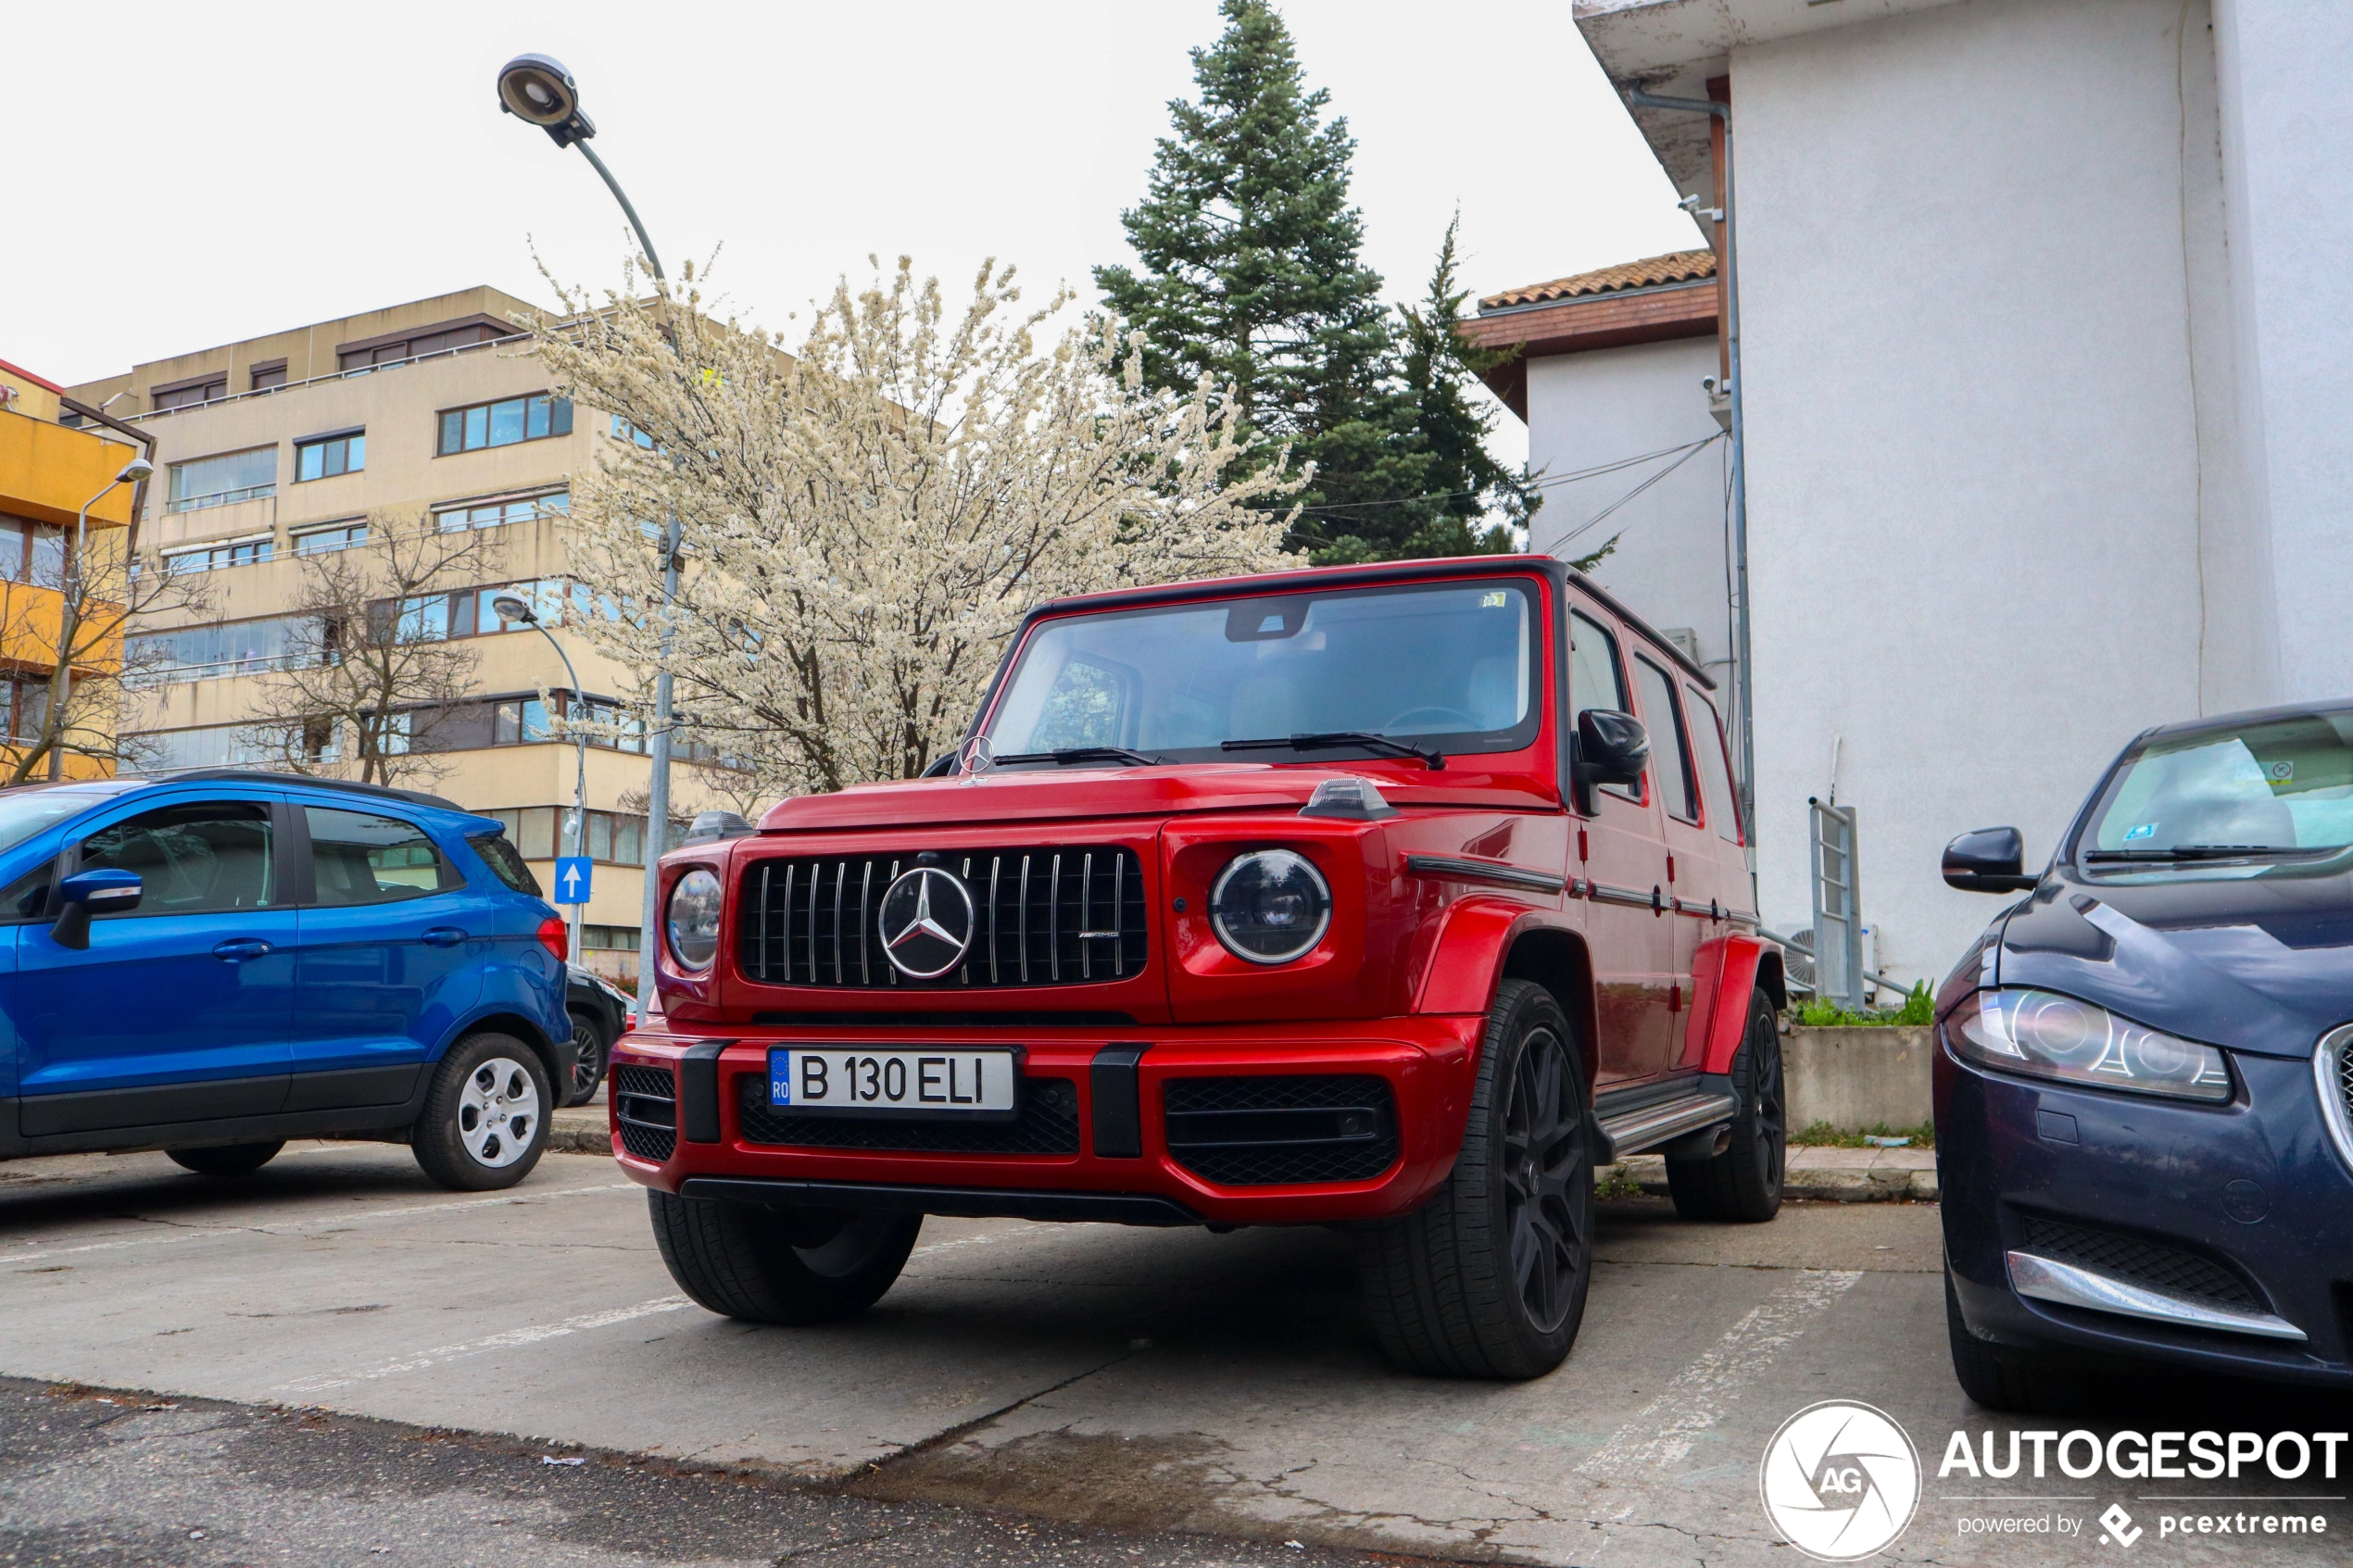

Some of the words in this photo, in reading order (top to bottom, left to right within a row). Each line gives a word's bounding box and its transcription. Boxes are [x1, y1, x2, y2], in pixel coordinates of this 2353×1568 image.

[773, 1081, 788, 1099] RO
[801, 1055, 828, 1099] B
[844, 1056, 906, 1101] 130
[917, 1057, 983, 1104] ELI
